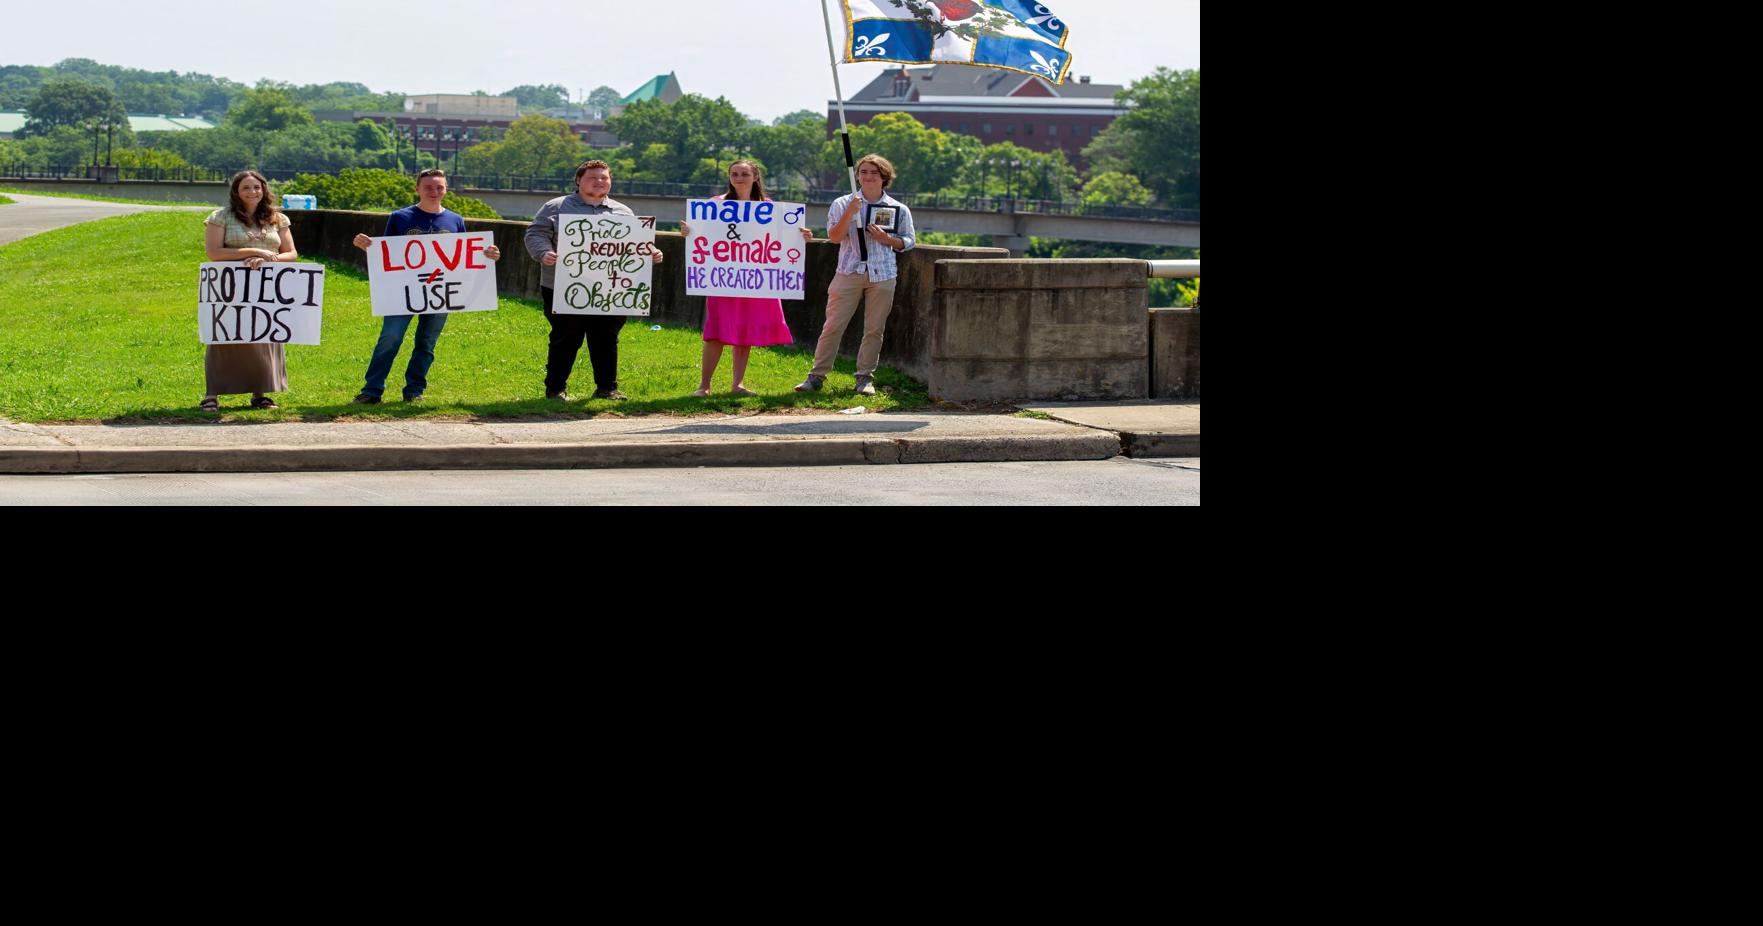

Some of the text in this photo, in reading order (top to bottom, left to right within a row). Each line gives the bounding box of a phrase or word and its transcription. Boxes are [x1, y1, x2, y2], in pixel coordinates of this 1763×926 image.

[691, 201, 774, 225] male
[565, 219, 631, 247] Pride
[726, 223, 741, 241] &
[381, 237, 487, 272] LOVE
[563, 249, 645, 278] People
[590, 241, 655, 257] REDUCES
[692, 233, 782, 265] female
[199, 267, 323, 306] PROTECT
[608, 271, 633, 288] to
[688, 267, 805, 291] HE CREATED THEM
[405, 282, 465, 313] USE
[565, 282, 650, 312] Objects
[211, 304, 292, 343] KIDS
